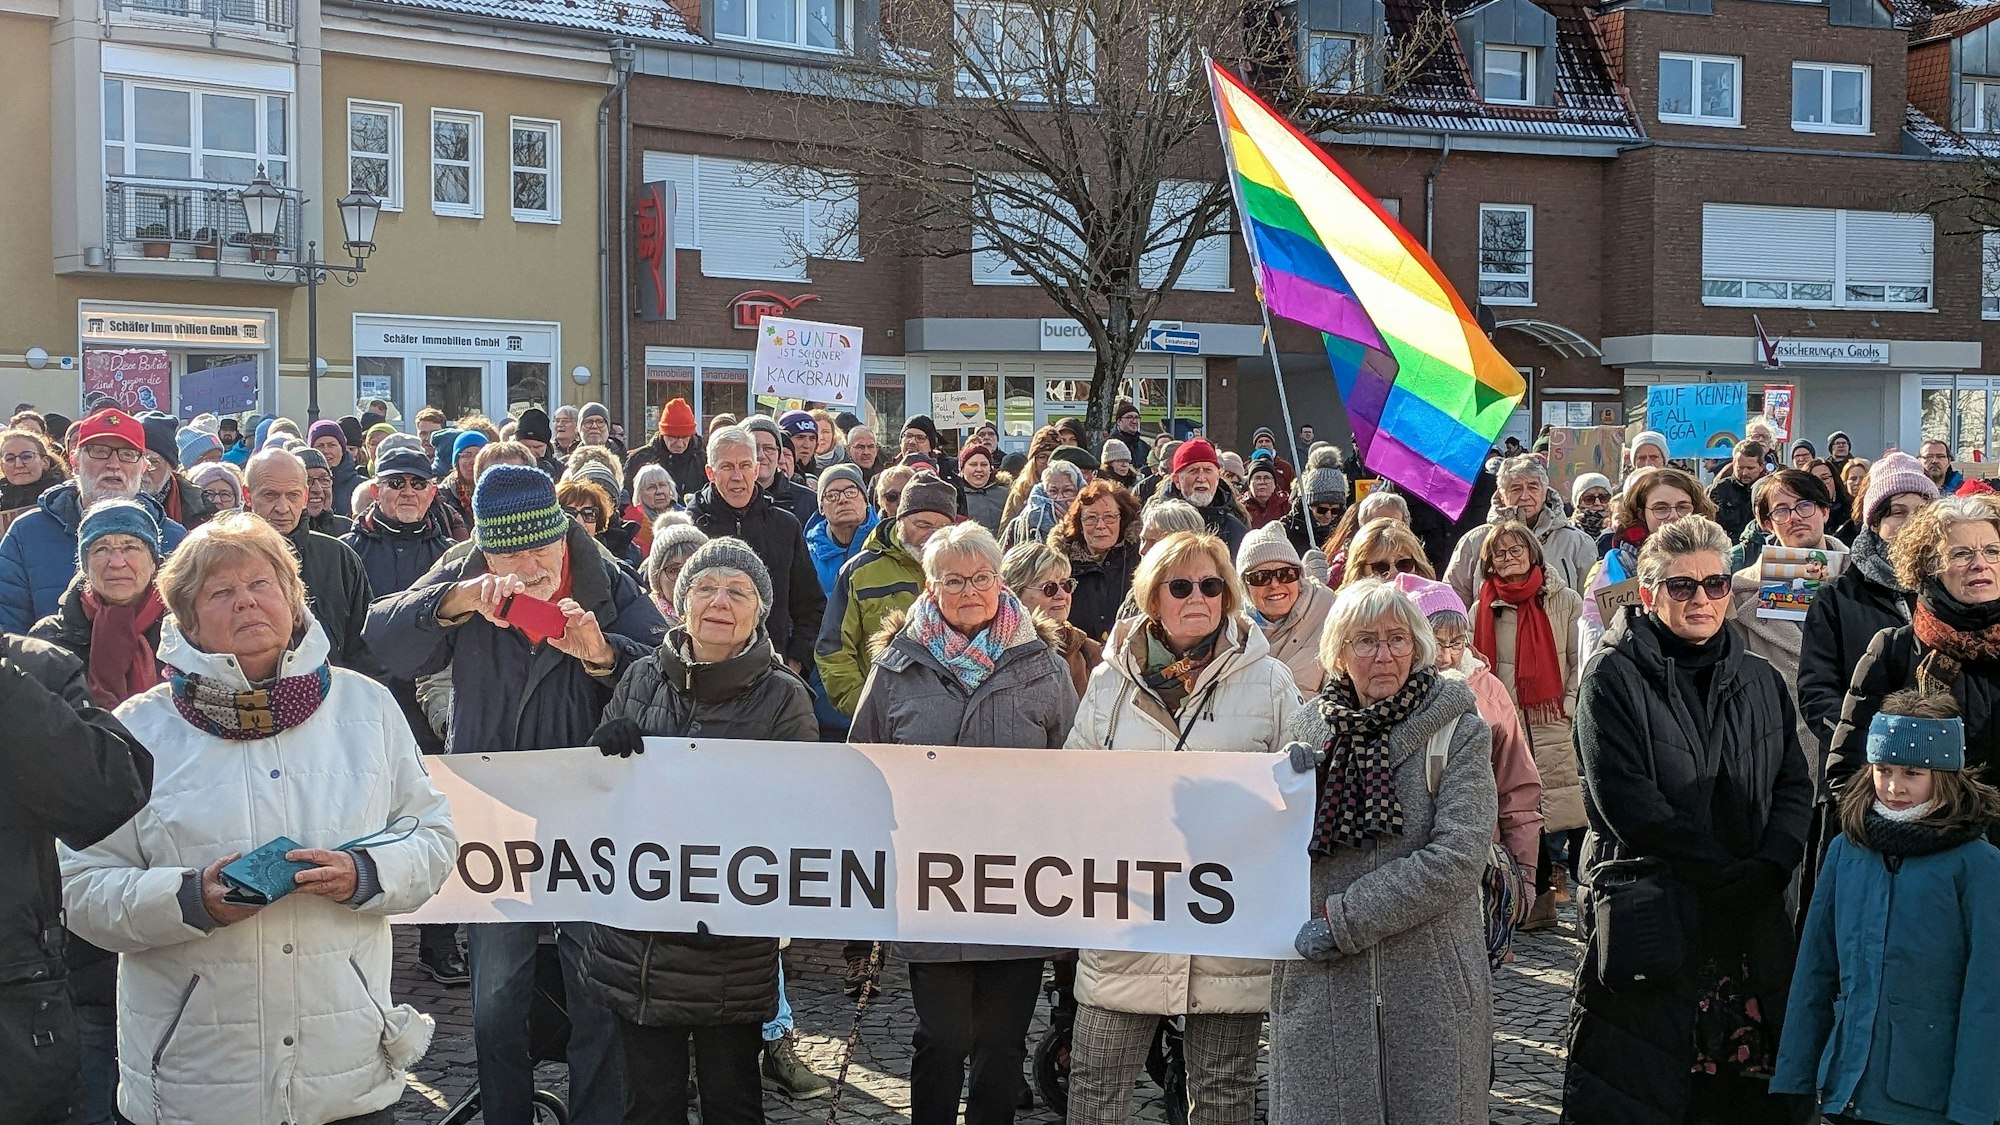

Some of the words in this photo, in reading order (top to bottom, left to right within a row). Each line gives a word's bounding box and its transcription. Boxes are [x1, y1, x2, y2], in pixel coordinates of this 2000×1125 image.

[109, 319, 149, 333] Schäfer
[151, 321, 208, 335] Immobilien
[210, 323, 238, 336] GmbH
[383, 333, 418, 344] Schäfer
[422, 335, 472, 346] Immobilien
[474, 337, 500, 347] GmbH
[786, 329, 838, 348] BUNT
[146, 373, 162, 385] die
[647, 367, 692, 378] Immobilien
[767, 366, 850, 388] KACKBRAUN
[1540, 366, 1546, 378] 7
[1650, 388, 1686, 408] AUF
[1695, 385, 1743, 406] KEINEN
[796, 420, 816, 431] Volt
[1651, 408, 1692, 427] FALL
[1597, 590, 1641, 609] Tran
[1762, 591, 1794, 602] NAZIS
[457, 837, 616, 896] OPAS
[628, 842, 887, 910] GEGEN
[917, 851, 1236, 926] RECHTS
